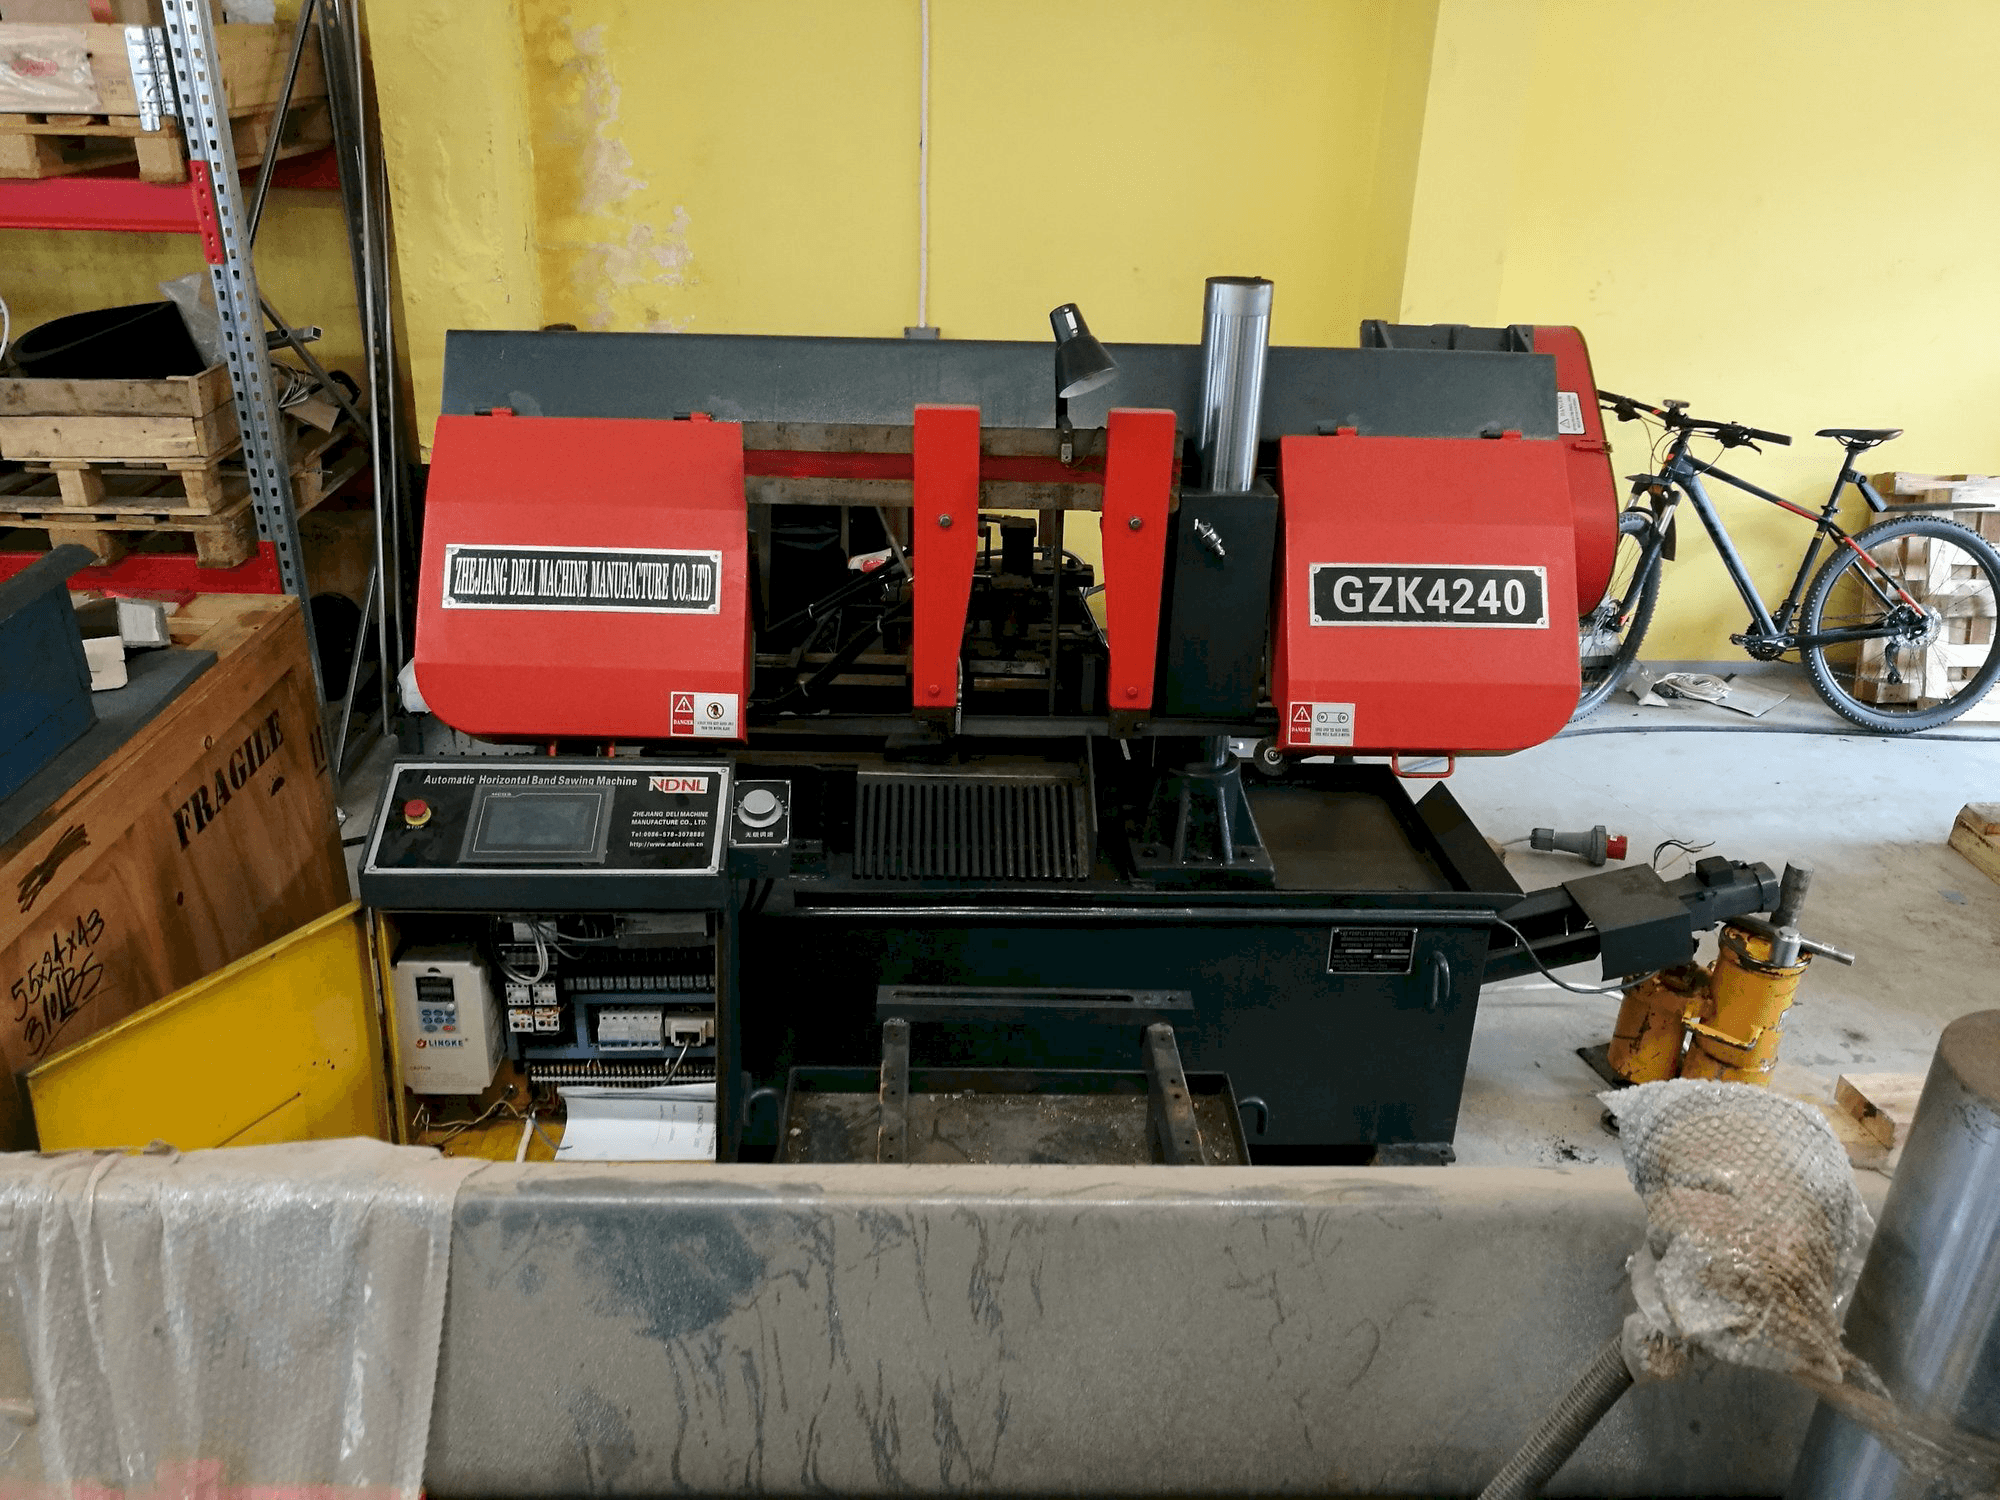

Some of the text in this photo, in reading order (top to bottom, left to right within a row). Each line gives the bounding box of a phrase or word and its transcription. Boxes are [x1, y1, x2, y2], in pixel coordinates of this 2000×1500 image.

[454, 557, 508, 596] ZHEJIANG
[509, 558, 537, 597] DELI
[538, 559, 588, 598] MACHINE
[590, 560, 669, 600] MANUFACTURE
[1333, 575, 1526, 616] GZK4240
[173, 709, 284, 851] FRAGILE
[424, 775, 638, 786] Automatic Horizontal Band Sawing Machine
[649, 777, 706, 793] NDNL
